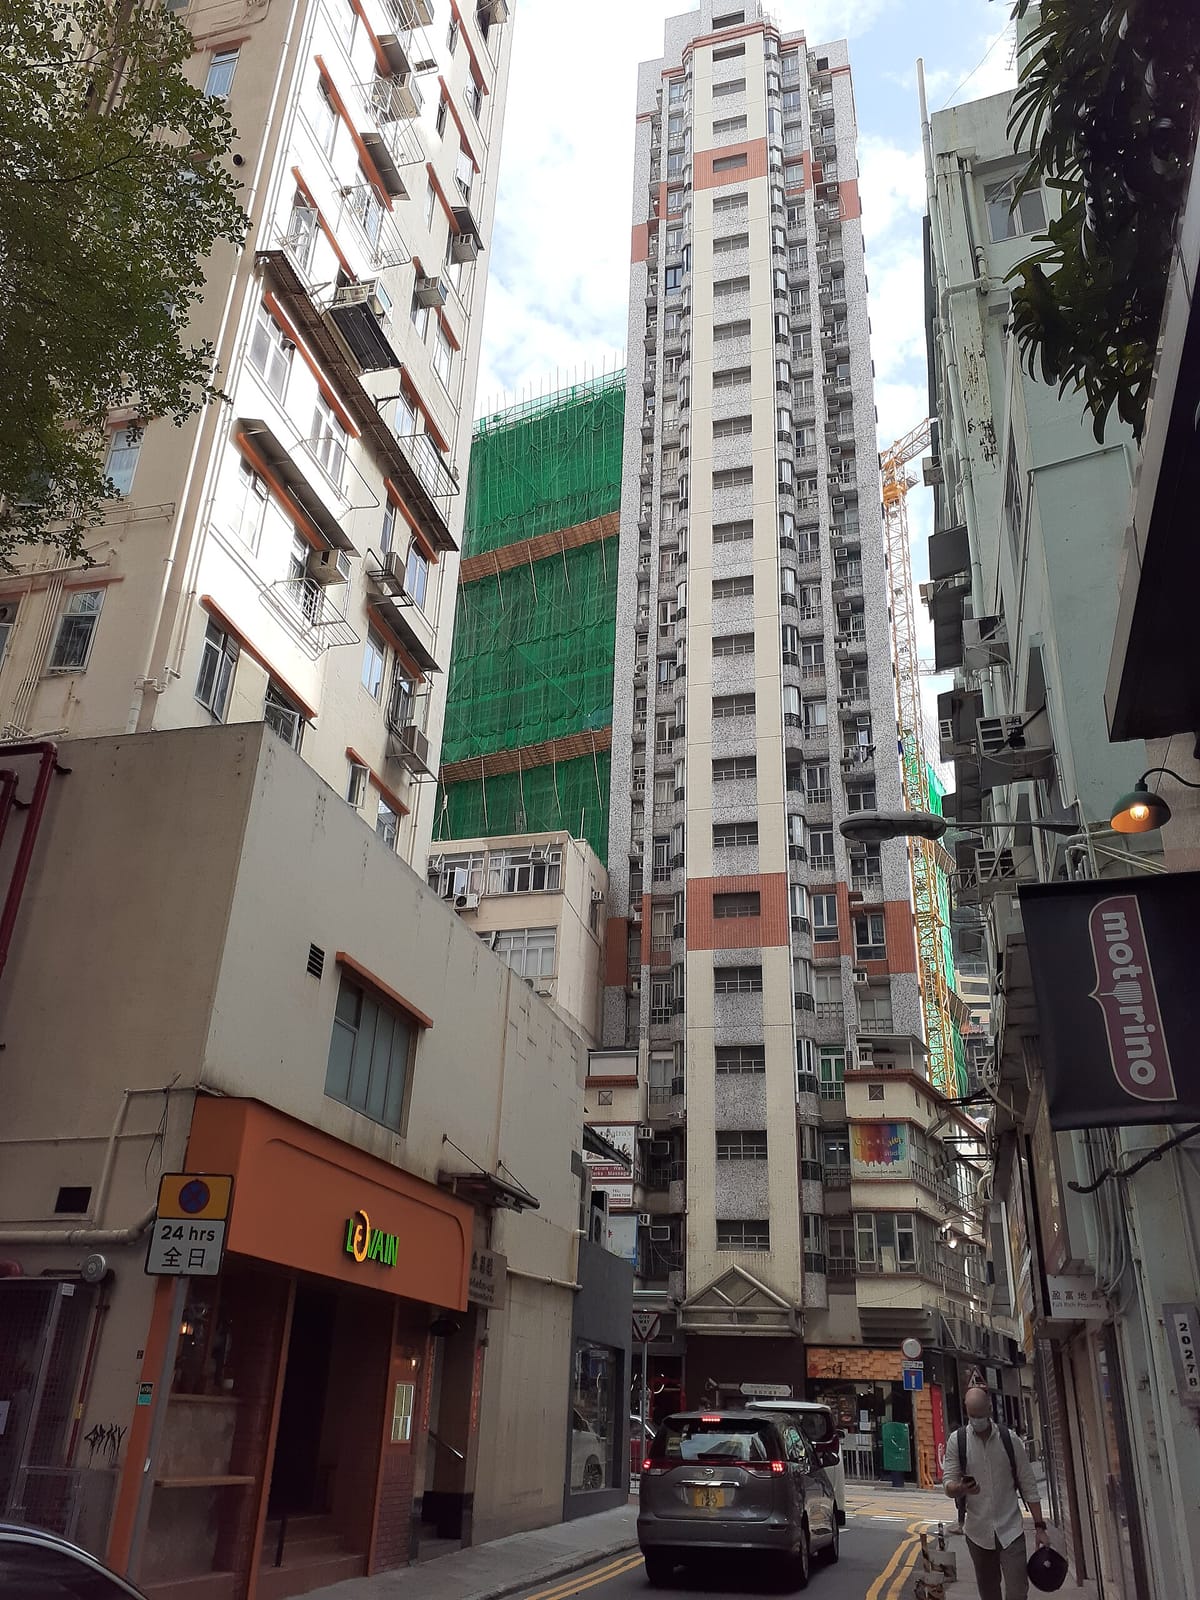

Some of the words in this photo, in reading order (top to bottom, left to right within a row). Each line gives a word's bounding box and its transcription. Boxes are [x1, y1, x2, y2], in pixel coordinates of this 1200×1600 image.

[161, 1225, 184, 1240] 24
[188, 1226, 215, 1242] hrs
[161, 1246, 205, 1268] 全日
[1179, 1322, 1198, 1387] 20278
